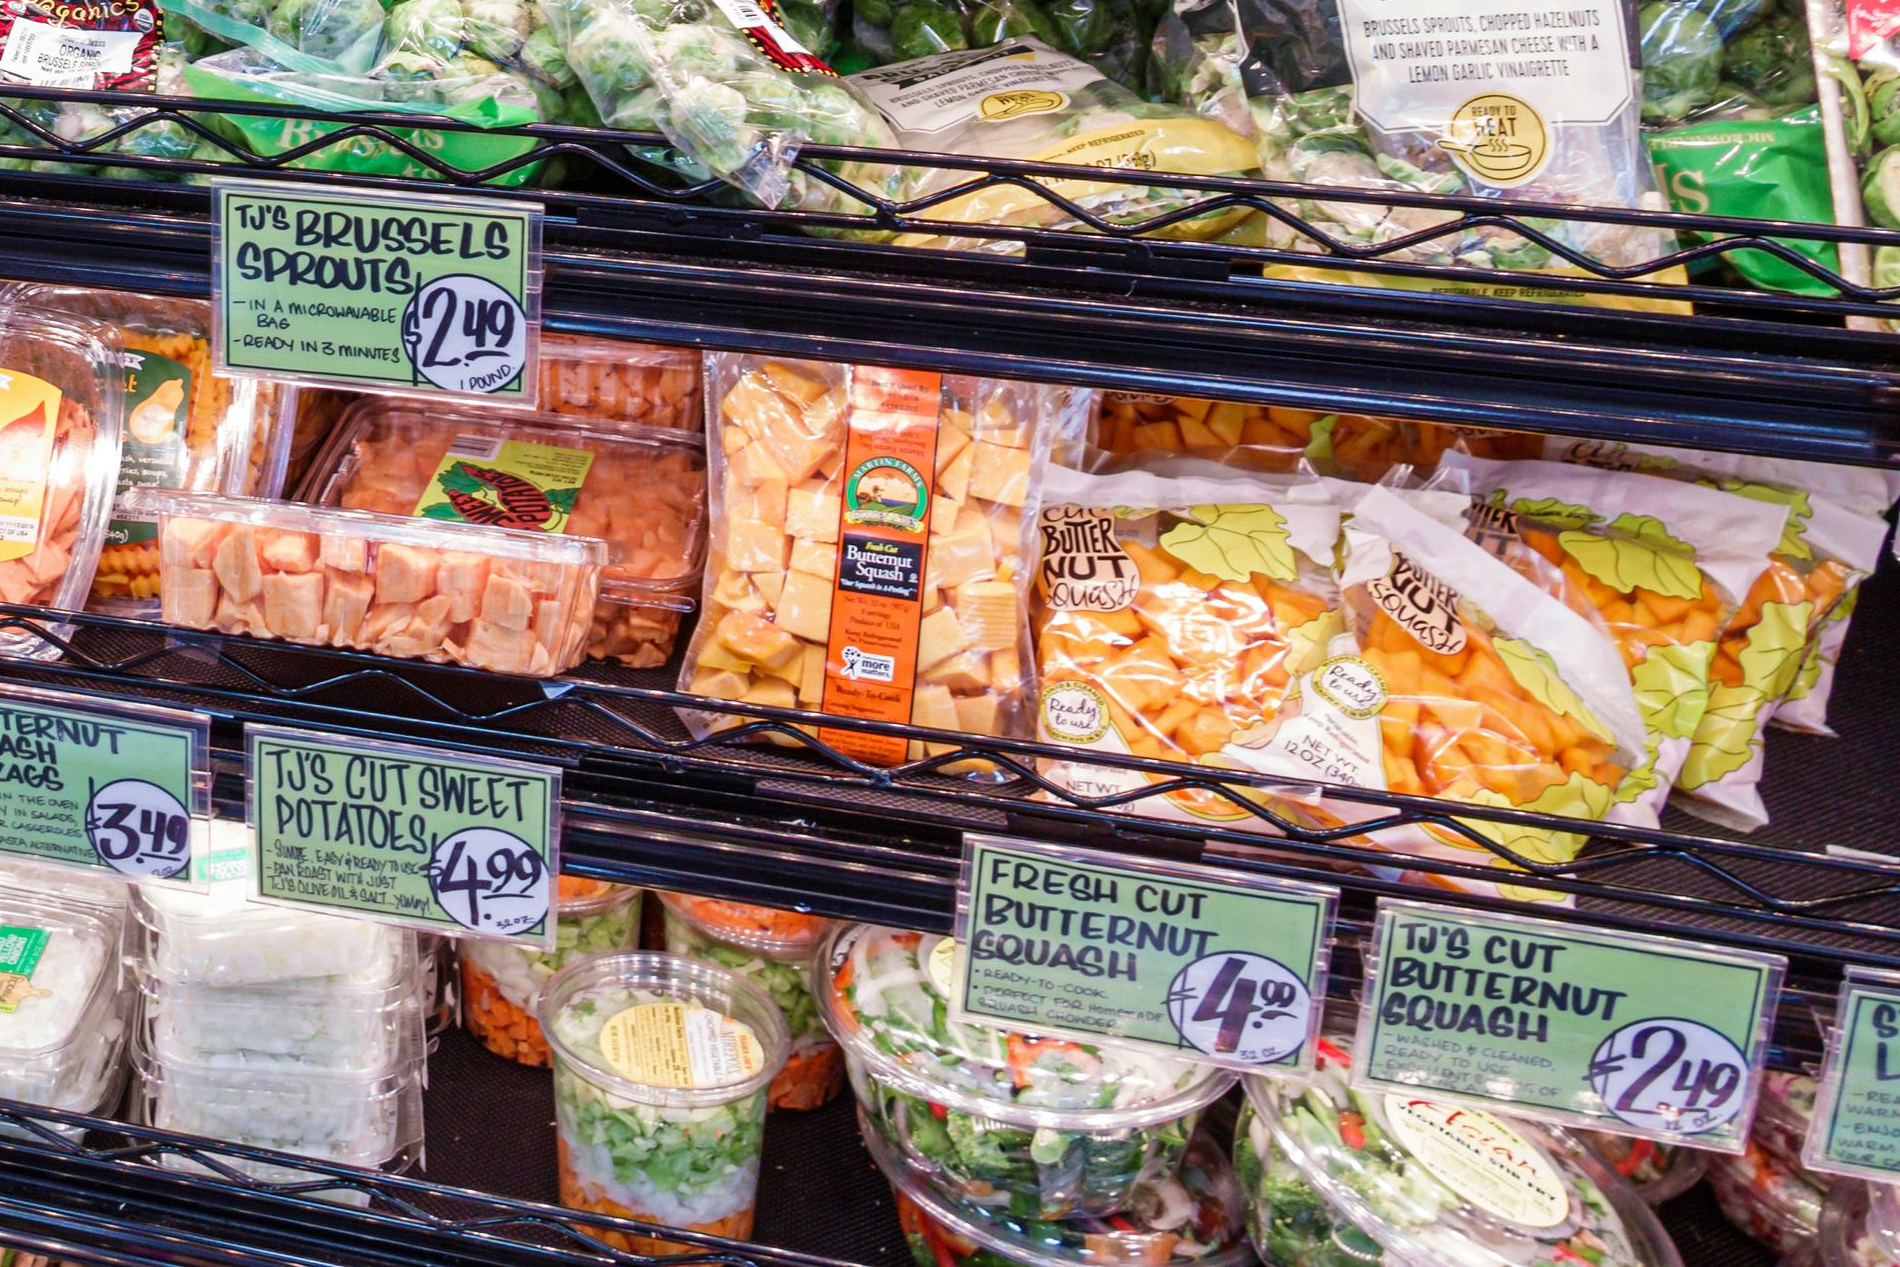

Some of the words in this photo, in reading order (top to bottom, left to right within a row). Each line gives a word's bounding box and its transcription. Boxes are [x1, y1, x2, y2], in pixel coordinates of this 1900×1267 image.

[1364, 18, 1420, 37] BRUSSELS
[1480, 14, 1531, 31] CHOPPED
[1534, 11, 1600, 30] HAZELNUTS
[1409, 66, 1448, 82] LEMON
[1453, 63, 1495, 80] GARLIC
[1495, 59, 1570, 78] VINAIGRETTE
[235, 204, 289, 230] TJ'S
[295, 211, 510, 258] BRUSSELS
[236, 249, 414, 294] SPROUTS
[257, 315, 289, 329] BAG
[336, 344, 400, 363] MINUTES
[848, 547, 913, 568] Butternut
[1043, 519, 1119, 555] BUTTER
[856, 561, 903, 582] Squash
[1044, 555, 1125, 584] NUT
[266, 751, 333, 795] TJ'S
[345, 761, 408, 804] CUT
[417, 766, 528, 821] SWEET
[277, 796, 427, 855] POTATOES
[992, 860, 1117, 901] FRESH
[1136, 887, 1209, 920] CUT
[985, 894, 1218, 958] BUTTERNUT
[1400, 922, 1469, 959] TJ'S
[1484, 936, 1566, 972] CUT
[973, 930, 1137, 981] SQUASH
[1391, 958, 1628, 1020] BUTTERNUT
[1382, 994, 1549, 1042] SQUASH
